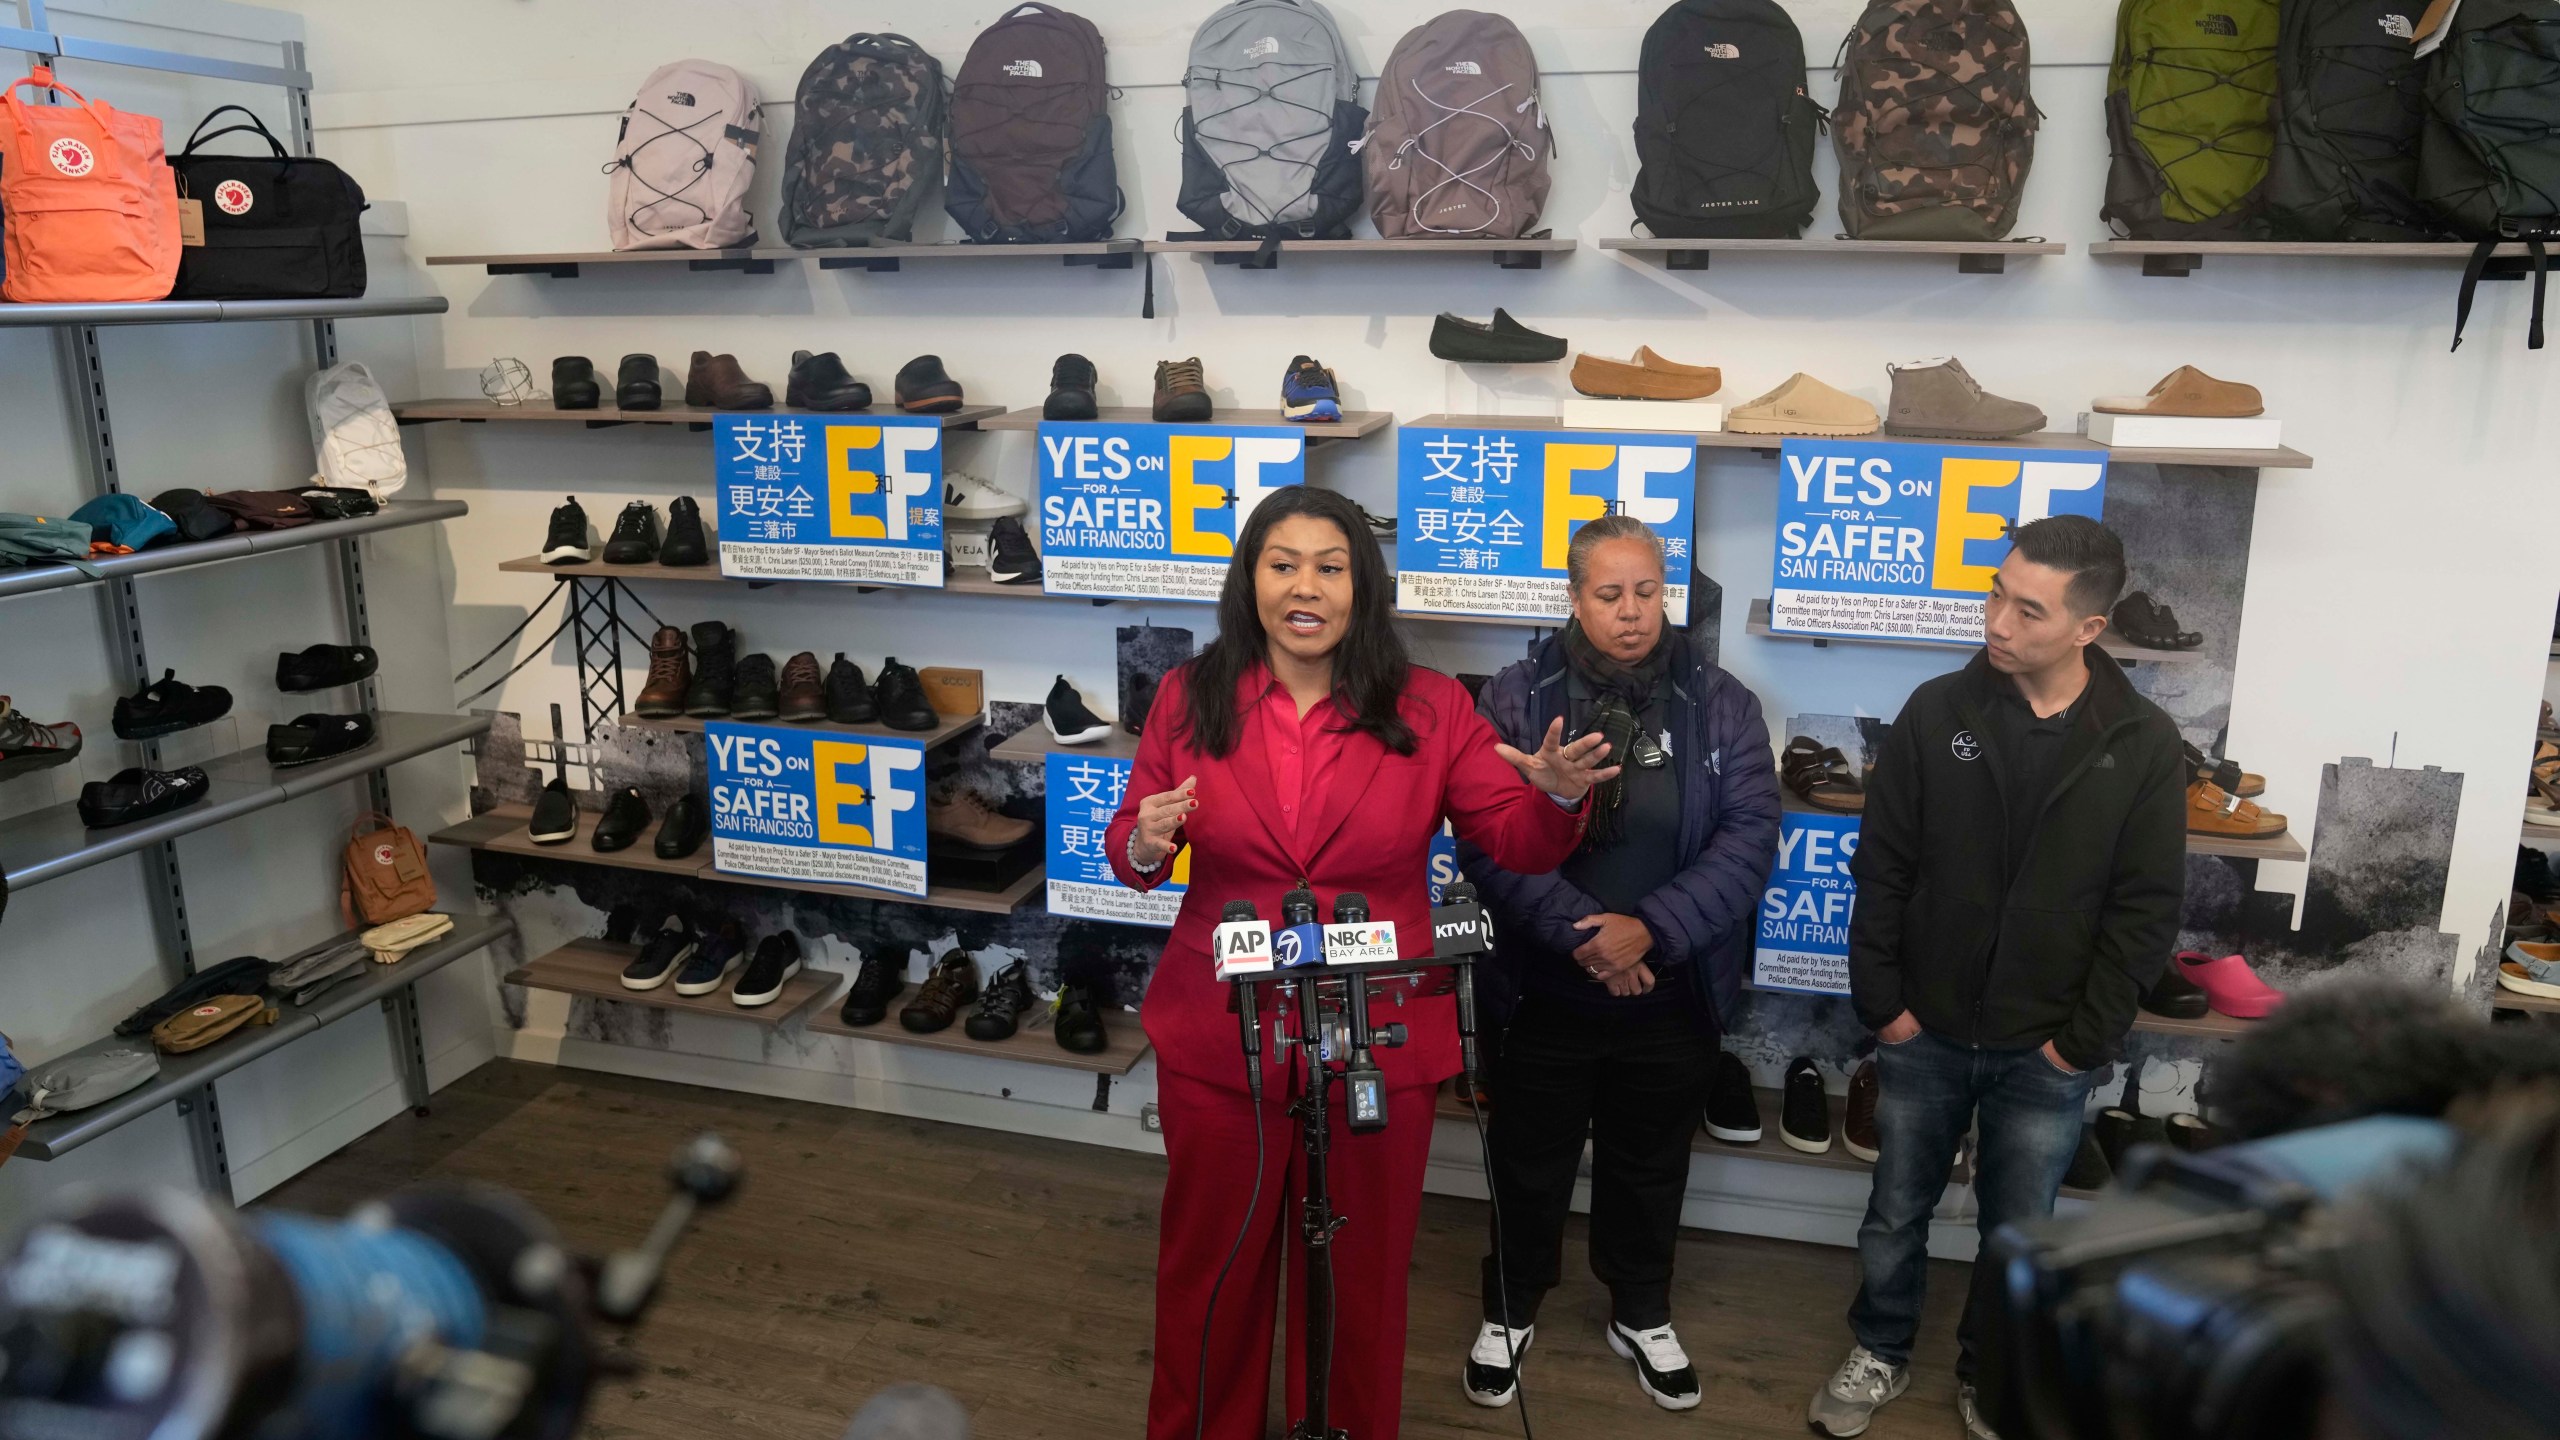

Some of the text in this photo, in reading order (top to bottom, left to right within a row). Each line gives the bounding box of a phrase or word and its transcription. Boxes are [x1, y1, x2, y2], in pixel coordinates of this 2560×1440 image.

[2378, 19, 2400, 29] NORTH
[732, 420, 806, 463] 支持
[1043, 436, 1163, 481] YES ON
[1422, 434, 1519, 484] 支持
[754, 465, 782, 480] 建設
[1787, 455, 1932, 506] YES ON
[1084, 484, 1120, 494] FOR A
[1451, 486, 1484, 504] 建設
[728, 485, 814, 518] 更安全
[909, 508, 939, 526] 提案
[1045, 496, 1163, 530] SAFER
[1832, 510, 1875, 522] FOR A
[748, 520, 796, 540] 三藩市
[1415, 508, 1524, 545] 更安全
[1046, 528, 1164, 550] SAN FRANCISCO
[1782, 522, 1924, 562] SAFER
[955, 546, 983, 554] VEJA
[1438, 548, 1500, 570] 三藩市
[1780, 558, 1924, 584] SAN FRANCISCO
[1443, 577, 1457, 586] Prop
[1478, 578, 1493, 587] Safer
[1495, 579, 1502, 587] SF
[1508, 580, 1525, 590] Mayor
[1527, 581, 1549, 590] Breed's
[1424, 598, 1441, 607] Police
[1443, 599, 1465, 608] Officers
[1466, 601, 1500, 610] Association
[1502, 602, 1514, 610] PAC
[1461, 589, 1476, 598] Chris
[1478, 590, 1497, 599] Larsen
[1538, 593, 1559, 602] Ronald
[1796, 594, 1805, 603] Ad
[1806, 594, 1820, 606] paid
[1821, 595, 1830, 604] for
[1831, 596, 1839, 607] by
[1841, 596, 1851, 606] Yes
[1863, 597, 1877, 609] Prop
[1880, 598, 1884, 607] E
[1886, 598, 1894, 608] for
[1901, 599, 1917, 609] Safer
[1919, 600, 1927, 610] SF
[1933, 601, 1952, 613] Mayor
[1954, 602, 1977, 613] Breed's
[1777, 604, 1810, 615] Committee
[1812, 606, 1829, 618] major
[1831, 608, 1854, 620] funding
[1856, 609, 1872, 619] from:
[1874, 609, 1890, 620] Chris
[1892, 611, 1913, 621] Larsen
[1950, 614, 1972, 625] Ronald
[1787, 617, 1805, 627] Police
[1807, 618, 1831, 629] Officers
[1832, 620, 1868, 630] Association
[1871, 622, 1884, 631] PAC
[1916, 624, 1944, 635] Financial
[1946, 626, 1982, 638] disclosures
[942, 676, 971, 687] ecco
[709, 734, 808, 776] YES ON
[744, 778, 774, 788] FOR A
[713, 786, 811, 822] SAFER
[716, 814, 813, 839] SAN FRANCISCO
[1778, 827, 1859, 875] YES
[1812, 878, 1852, 890] FOR A
[1764, 887, 1856, 925] SAF
[1329, 930, 1367, 947] NBC
[1436, 920, 1476, 938] KTVU
[1763, 920, 1797, 941] SAN
[1229, 931, 1265, 954] AP
[1278, 931, 1300, 964] 7
[1330, 947, 1394, 958] BAY AREA
[1759, 962, 1790, 973] Committee
[1792, 966, 1809, 976] major
[1810, 967, 1832, 979] funding
[1777, 954, 1786, 962] Ad
[1787, 955, 1800, 964] paid
[1801, 956, 1809, 964] for
[1811, 956, 1818, 967] by
[1820, 957, 1830, 966] Yes
[1768, 974, 1846, 989] Police Officers Association
